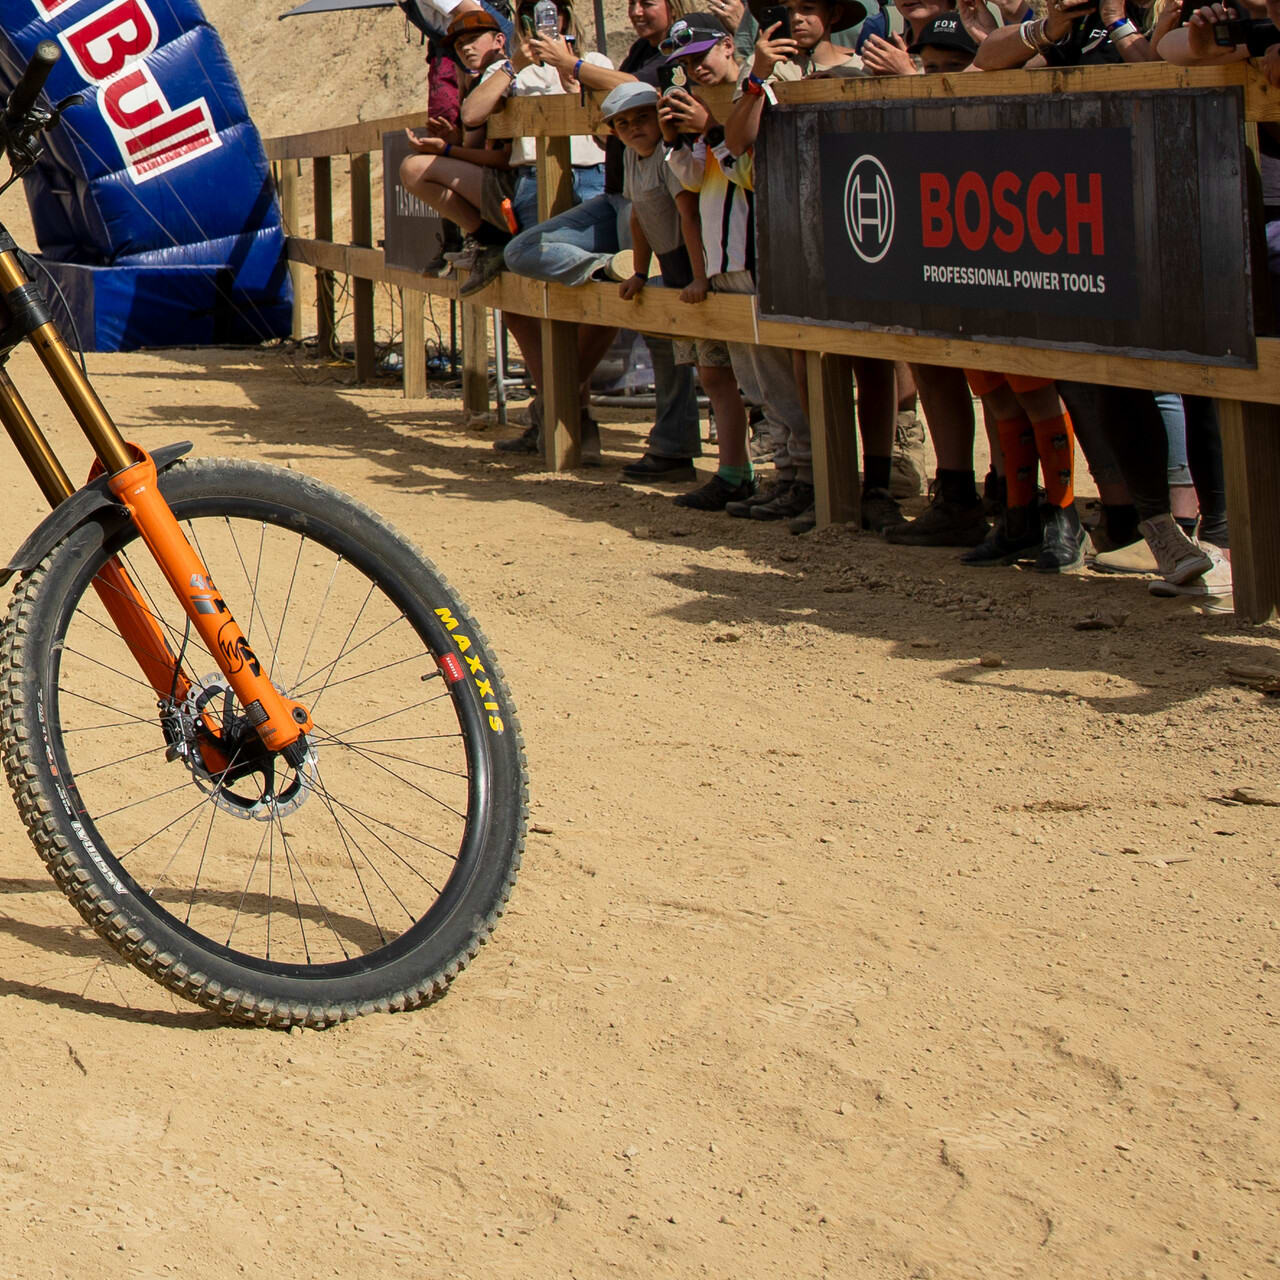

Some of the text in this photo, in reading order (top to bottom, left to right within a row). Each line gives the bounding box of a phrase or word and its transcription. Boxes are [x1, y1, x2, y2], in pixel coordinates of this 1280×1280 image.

[933, 20, 958, 29] FOX
[919, 171, 1105, 256] BOSCH
[922, 264, 1105, 294] PROFESSIONAL POWER TOOLS
[434, 607, 505, 736] MAXXIS
